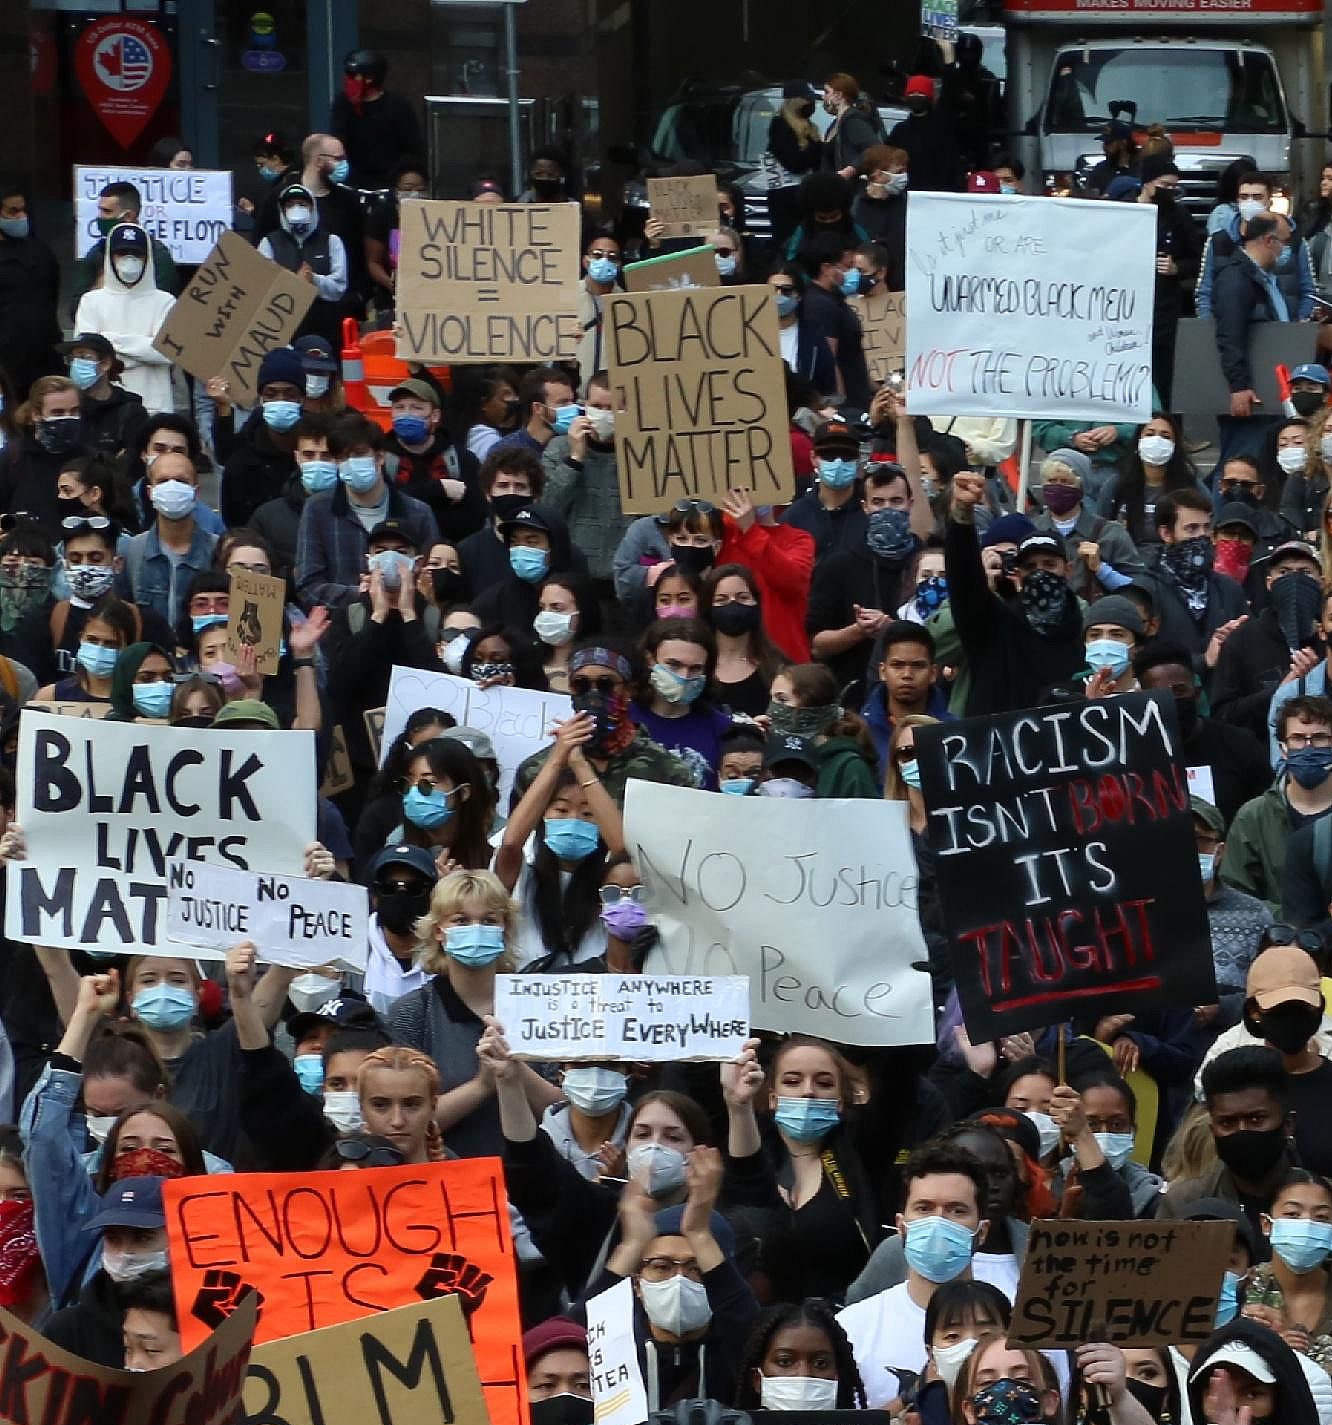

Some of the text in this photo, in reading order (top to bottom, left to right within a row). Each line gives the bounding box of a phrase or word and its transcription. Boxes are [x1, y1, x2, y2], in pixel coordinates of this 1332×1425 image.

[422, 207, 555, 248] WHITE
[420, 244, 563, 286] SILENCE
[164, 241, 233, 357] I RUN
[929, 273, 1022, 316] UNARMED
[1023, 278, 1086, 322] BLACK
[1087, 286, 1136, 321] MEN
[230, 291, 296, 390] MAUD
[404, 312, 578, 358] VIOLENCE
[611, 295, 774, 367] BLACK
[908, 348, 968, 394] NOT
[969, 349, 1021, 394] THE
[634, 369, 767, 432] LIVES
[623, 427, 782, 500] MATTER
[942, 699, 1174, 792] RACISM
[34, 729, 263, 821] BLACK
[1066, 761, 1190, 834] BORN
[180, 899, 249, 934] JUSTICE
[289, 905, 353, 940] PEACE
[957, 898, 1156, 998] TAUGHT
[510, 978, 714, 998] INJUSTICE ANYWHERE
[590, 998, 664, 1012] threat to
[521, 1006, 748, 1045] JUSTICE EVERYWHERE
[178, 1180, 504, 1270] ENOUGH
[1030, 1228, 1178, 1252] now is not
[1083, 1253, 1157, 1276] time
[1043, 1277, 1094, 1299] for
[1022, 1296, 1218, 1342] SILENCE
